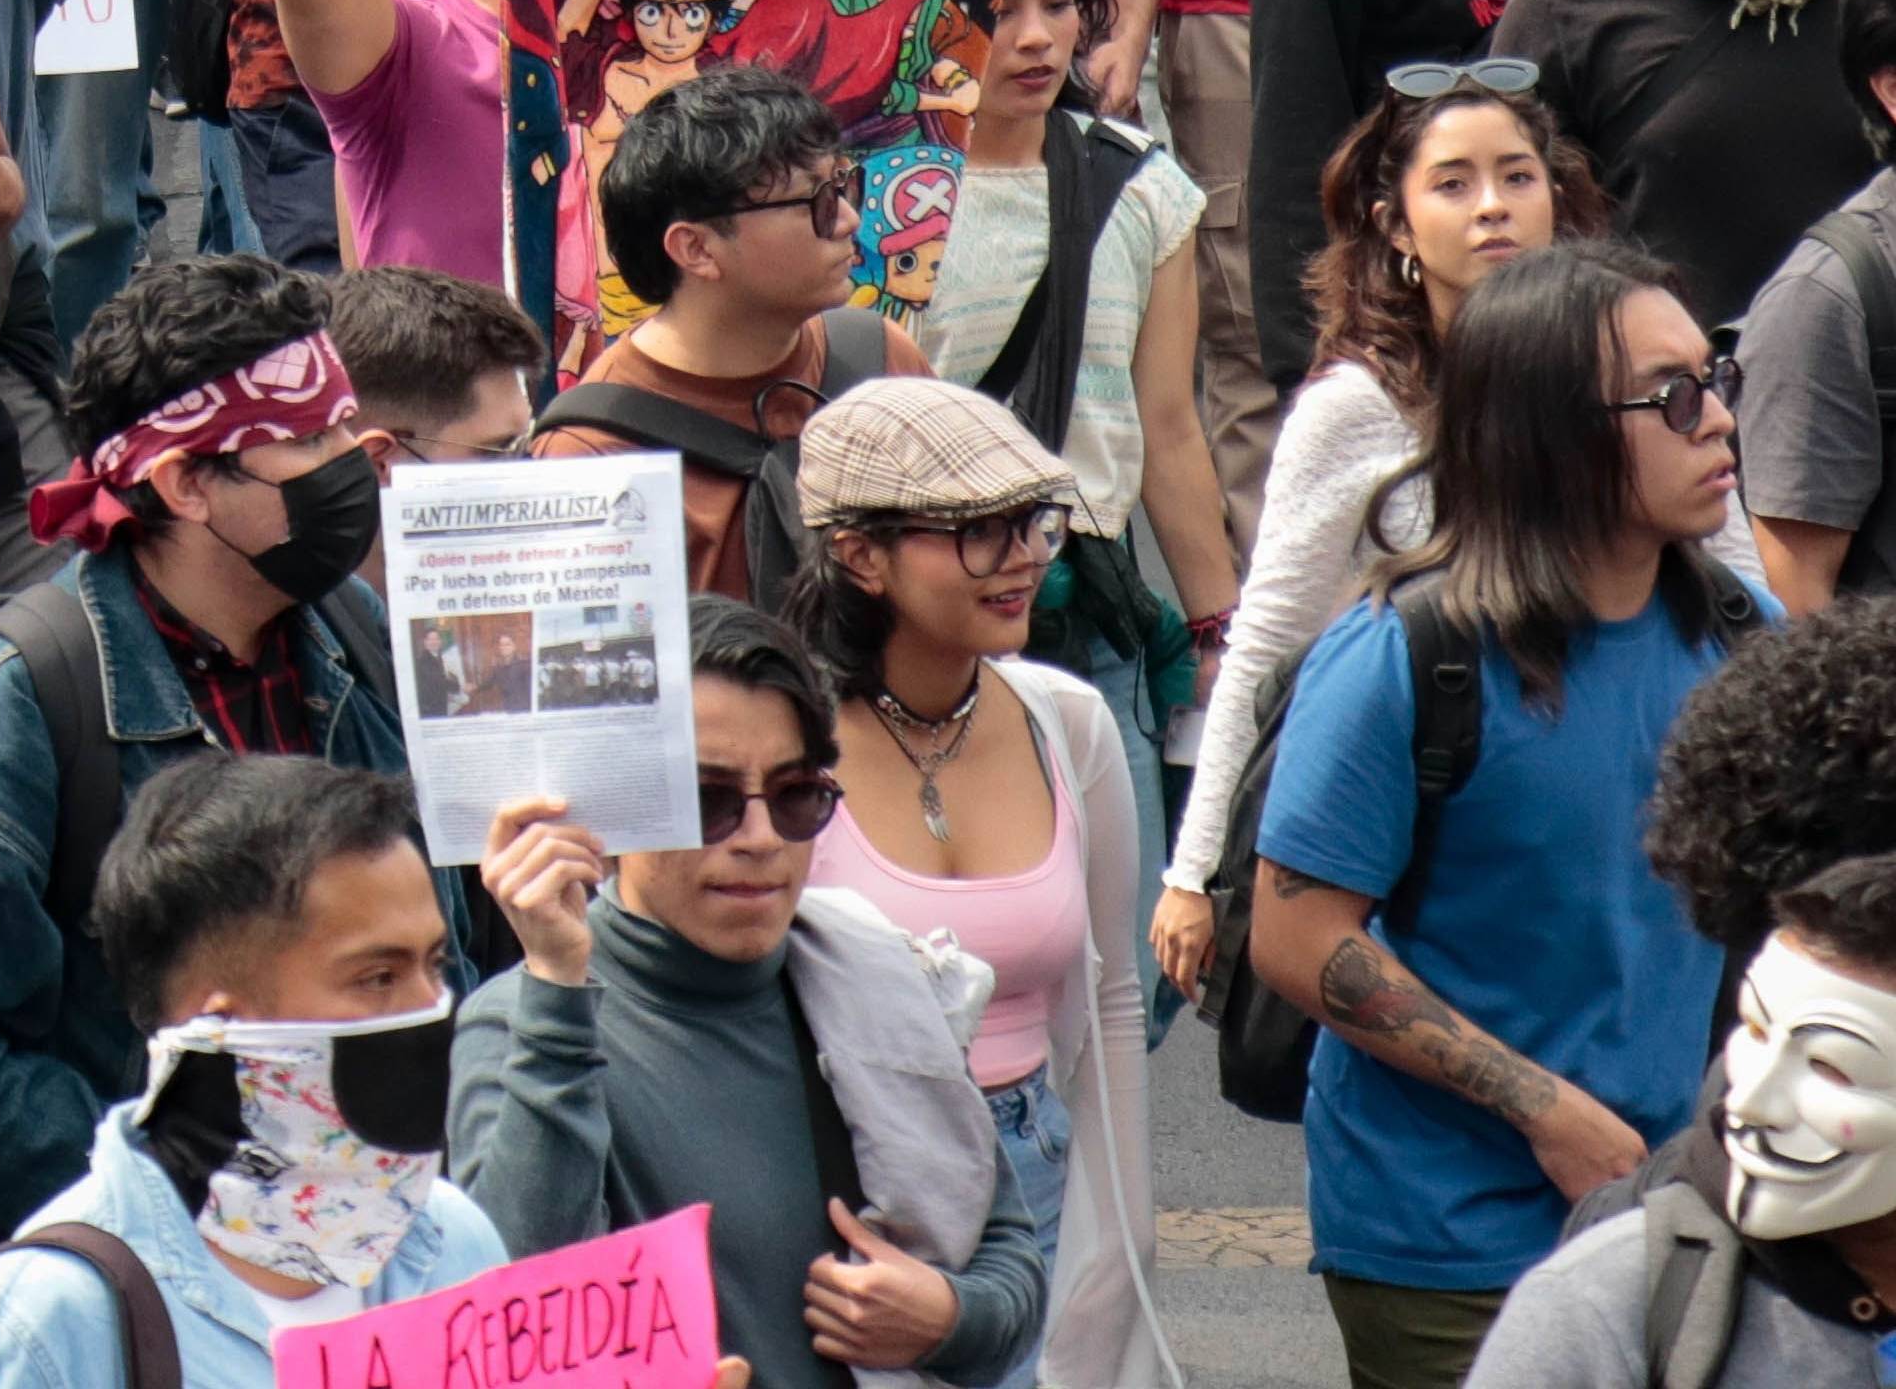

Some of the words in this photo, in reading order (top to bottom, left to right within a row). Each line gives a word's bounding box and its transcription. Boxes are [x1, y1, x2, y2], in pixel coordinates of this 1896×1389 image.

[442, 570, 488, 589] lucha
[493, 567, 545, 588] obrera
[551, 570, 559, 586] y
[563, 562, 652, 584] campesina
[437, 595, 458, 611] en
[462, 590, 528, 610] defensa
[533, 588, 552, 604] de
[446, 1246, 689, 1389] REBELDÍA
